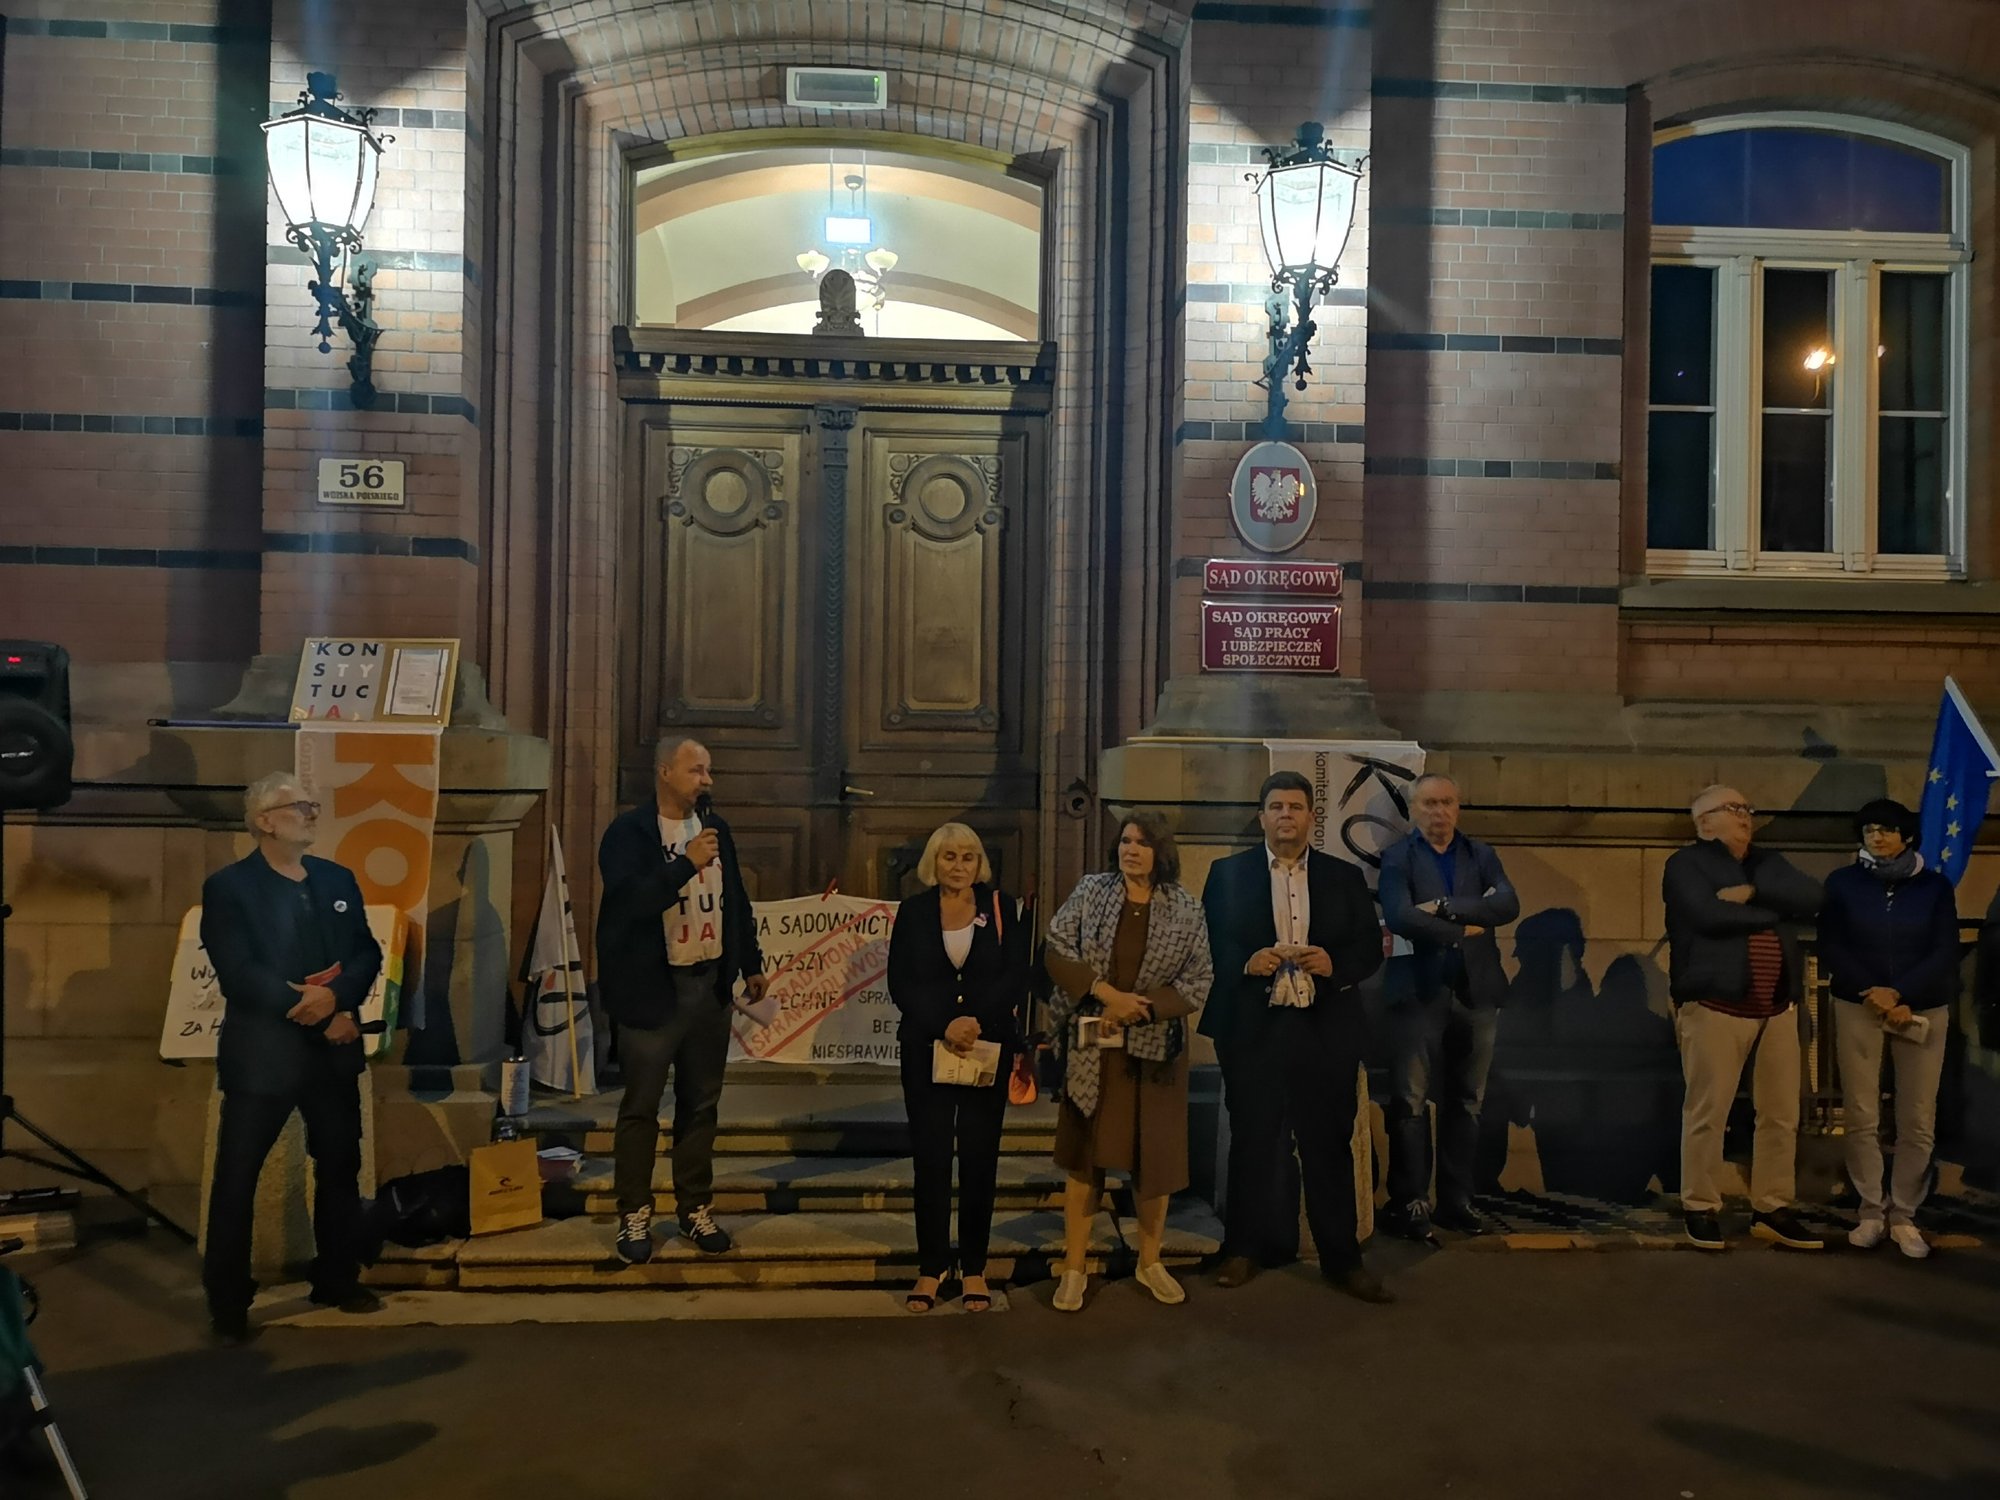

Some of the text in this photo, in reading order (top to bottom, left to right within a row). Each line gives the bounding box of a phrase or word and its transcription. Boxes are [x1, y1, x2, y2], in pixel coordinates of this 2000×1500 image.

[339, 464, 385, 489] 56
[1209, 569, 1339, 589] SĄD OKRĘGOWY
[1212, 611, 1332, 627] SĄD OKRĘGOWY
[1234, 627, 1311, 640] SĄD PRACY
[1221, 639, 1322, 653] I UBEZPIECZEŃ
[1222, 654, 1321, 667] SPOŁECZNYCH
[1315, 752, 1330, 803] komitet
